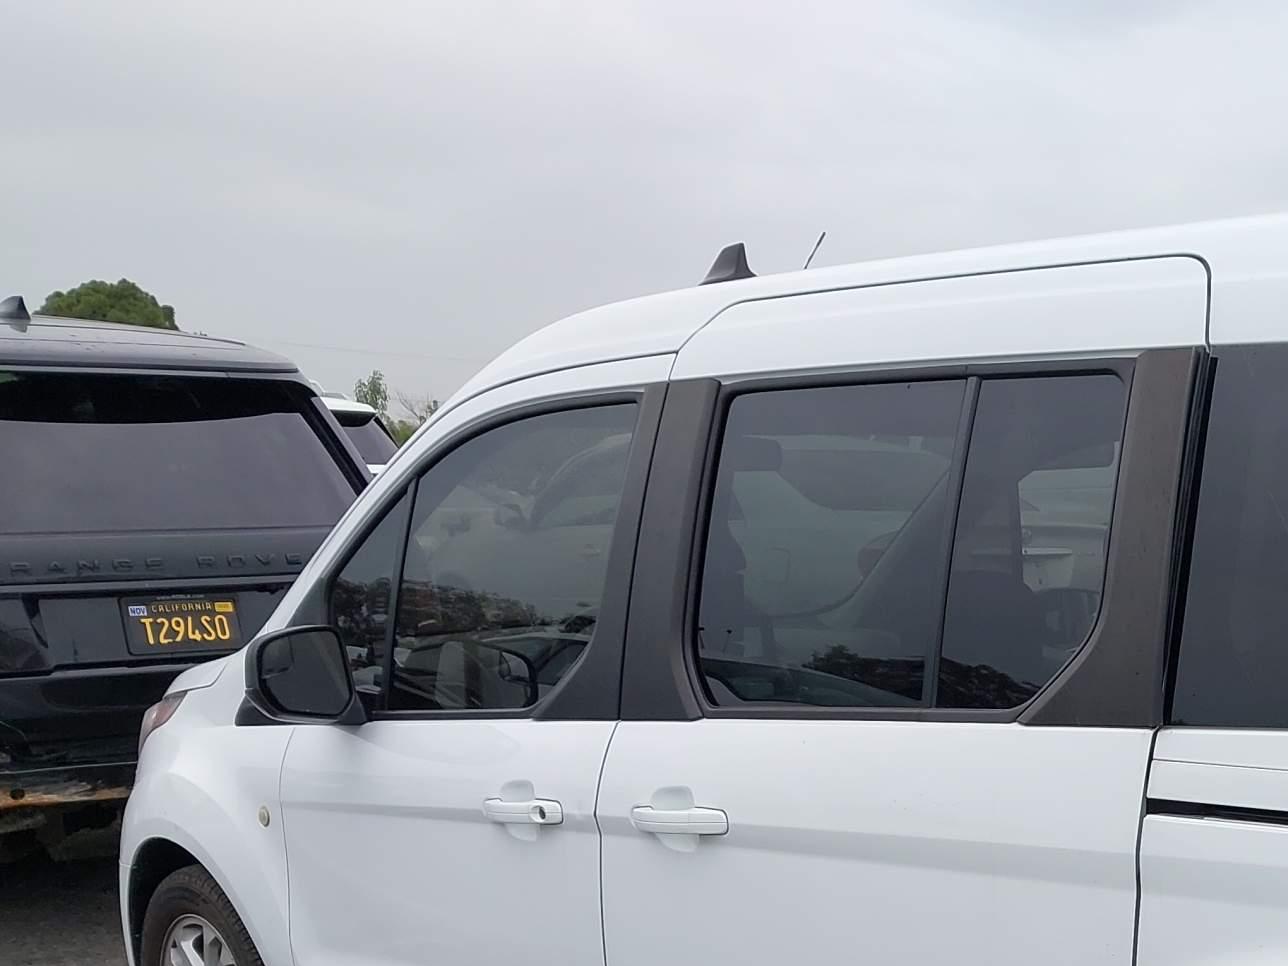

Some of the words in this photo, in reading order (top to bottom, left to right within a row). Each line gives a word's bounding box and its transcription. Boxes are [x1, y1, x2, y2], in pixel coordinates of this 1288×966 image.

[9, 558, 166, 577] RANGE
[196, 553, 302, 568] ROVE
[129, 606, 147, 616] NOV
[151, 602, 212, 613] CALIFORNIA
